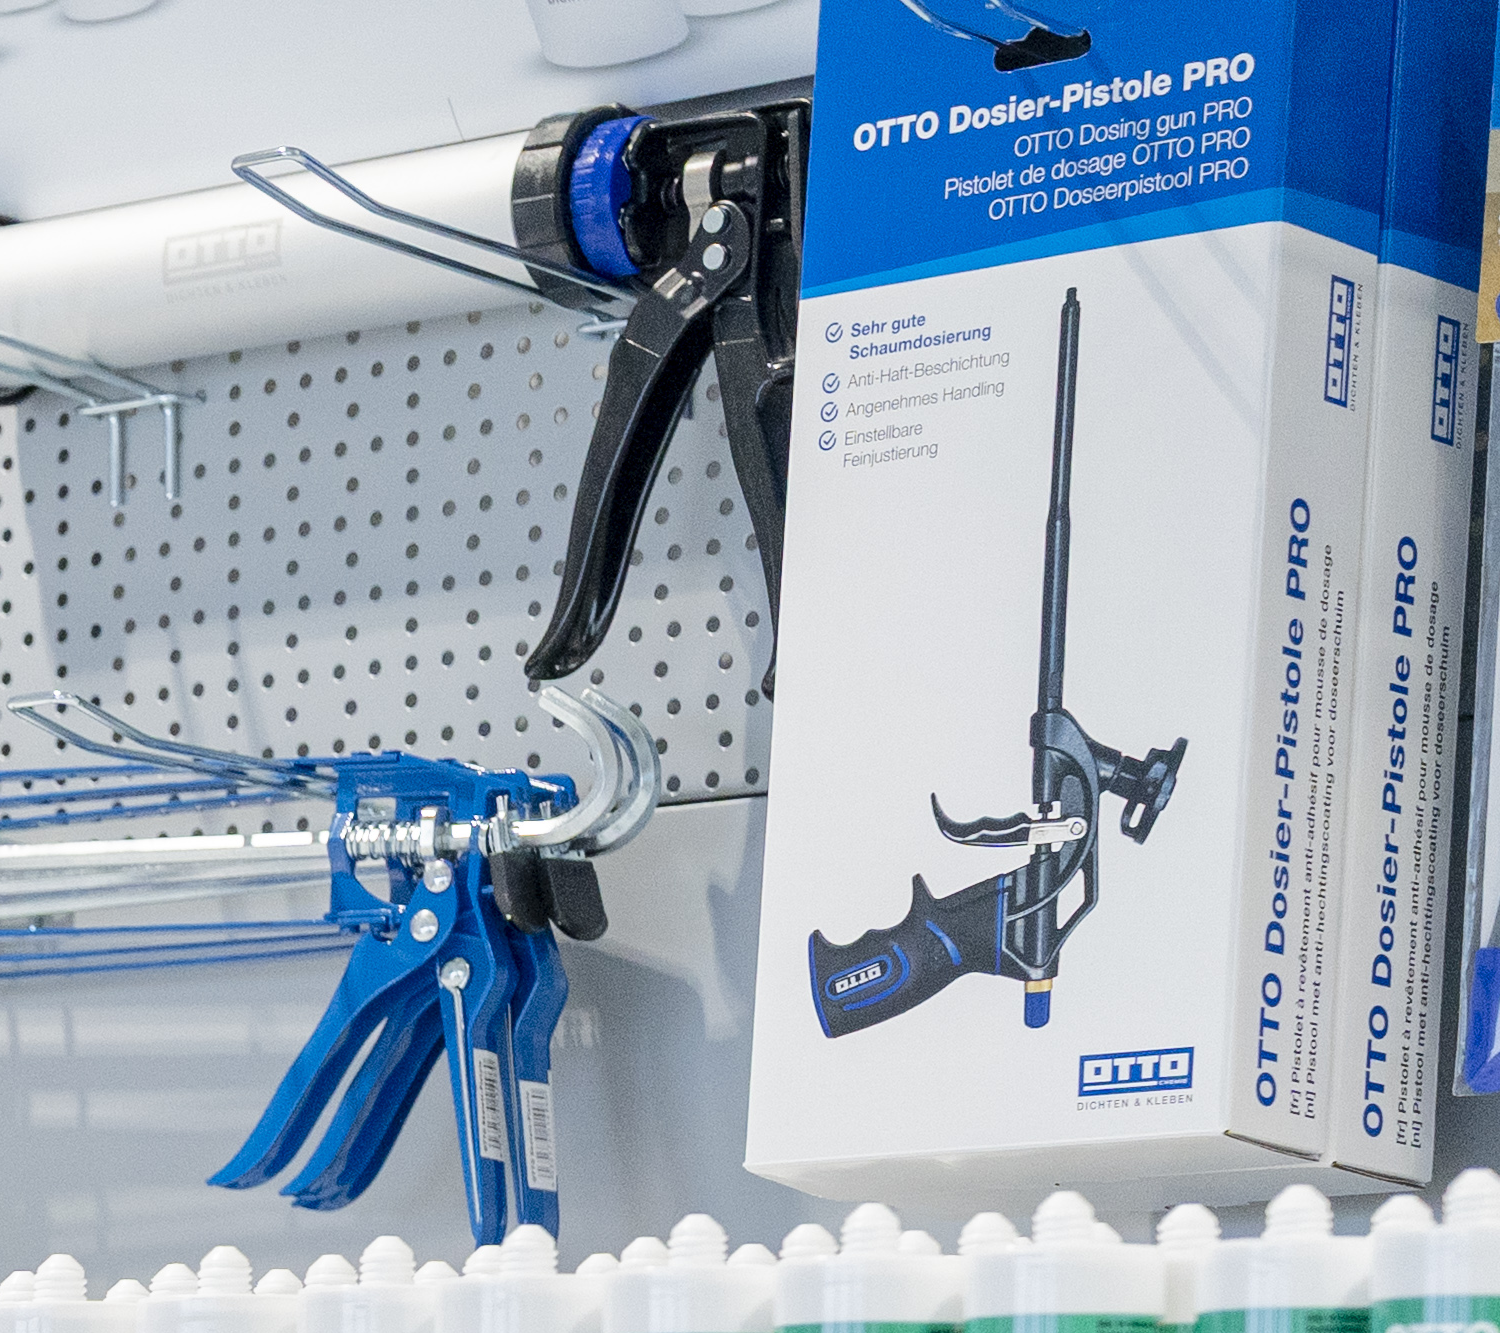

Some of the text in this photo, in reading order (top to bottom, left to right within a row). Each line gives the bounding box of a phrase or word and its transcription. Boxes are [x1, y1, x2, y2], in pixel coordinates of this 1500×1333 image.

[853, 52, 1256, 152] OTTO Dosier-Pistole PRO
[1014, 96, 1253, 158] OTTO Dosing gun PRO
[945, 126, 1252, 200] Pistolet de dosage OTTO PRO
[988, 156, 1250, 221] OTTO Doseerpistool PRO
[849, 326, 992, 360] Schaumdosierung
[850, 314, 926, 337] Sehr gute
[1327, 281, 1348, 401] OTTO
[847, 351, 1010, 389] Anti-Haft-Beschichtung
[845, 381, 1005, 418] Angenehmes Handling
[843, 443, 939, 468] Feinjustierung
[844, 423, 923, 446] Einstellbare
[1320, 544, 1332, 612] dosage
[1318, 617, 1328, 641] de
[1315, 645, 1326, 719] mousse
[1311, 723, 1321, 768] pour
[1256, 498, 1310, 1107] OTTO Dosier-Pistole PRO
[1304, 771, 1319, 887] anti-adhésif
[1298, 889, 1312, 993] revêtement
[835, 966, 881, 993] OTTO
[1083, 1052, 1190, 1083] OTTO
[1291, 1006, 1304, 1083] Pistolet
[1077, 1094, 1193, 1111] DICHTEN & KLEBEN
